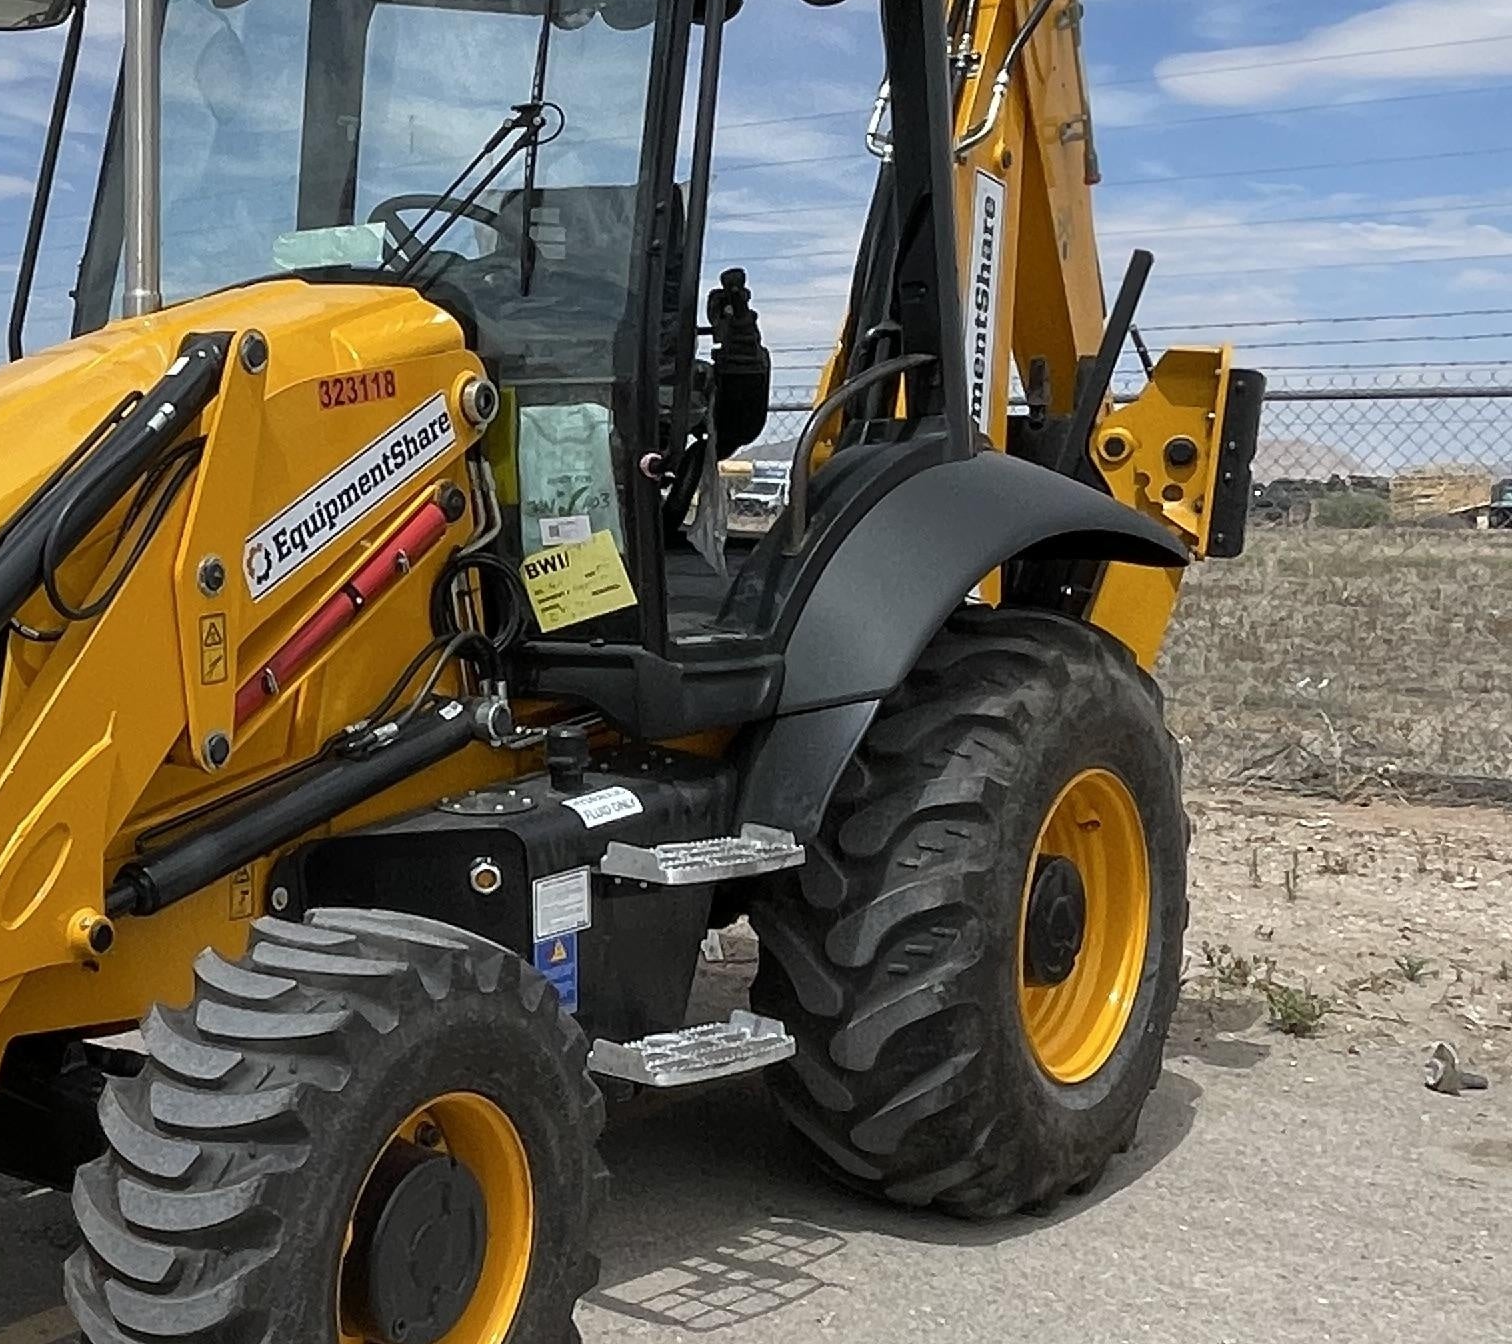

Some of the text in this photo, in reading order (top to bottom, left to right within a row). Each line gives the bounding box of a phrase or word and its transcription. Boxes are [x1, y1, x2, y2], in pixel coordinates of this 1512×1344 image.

[319, 369, 396, 409] 323118
[972, 196, 996, 432] mentShare
[272, 412, 451, 563] EquipmentShare
